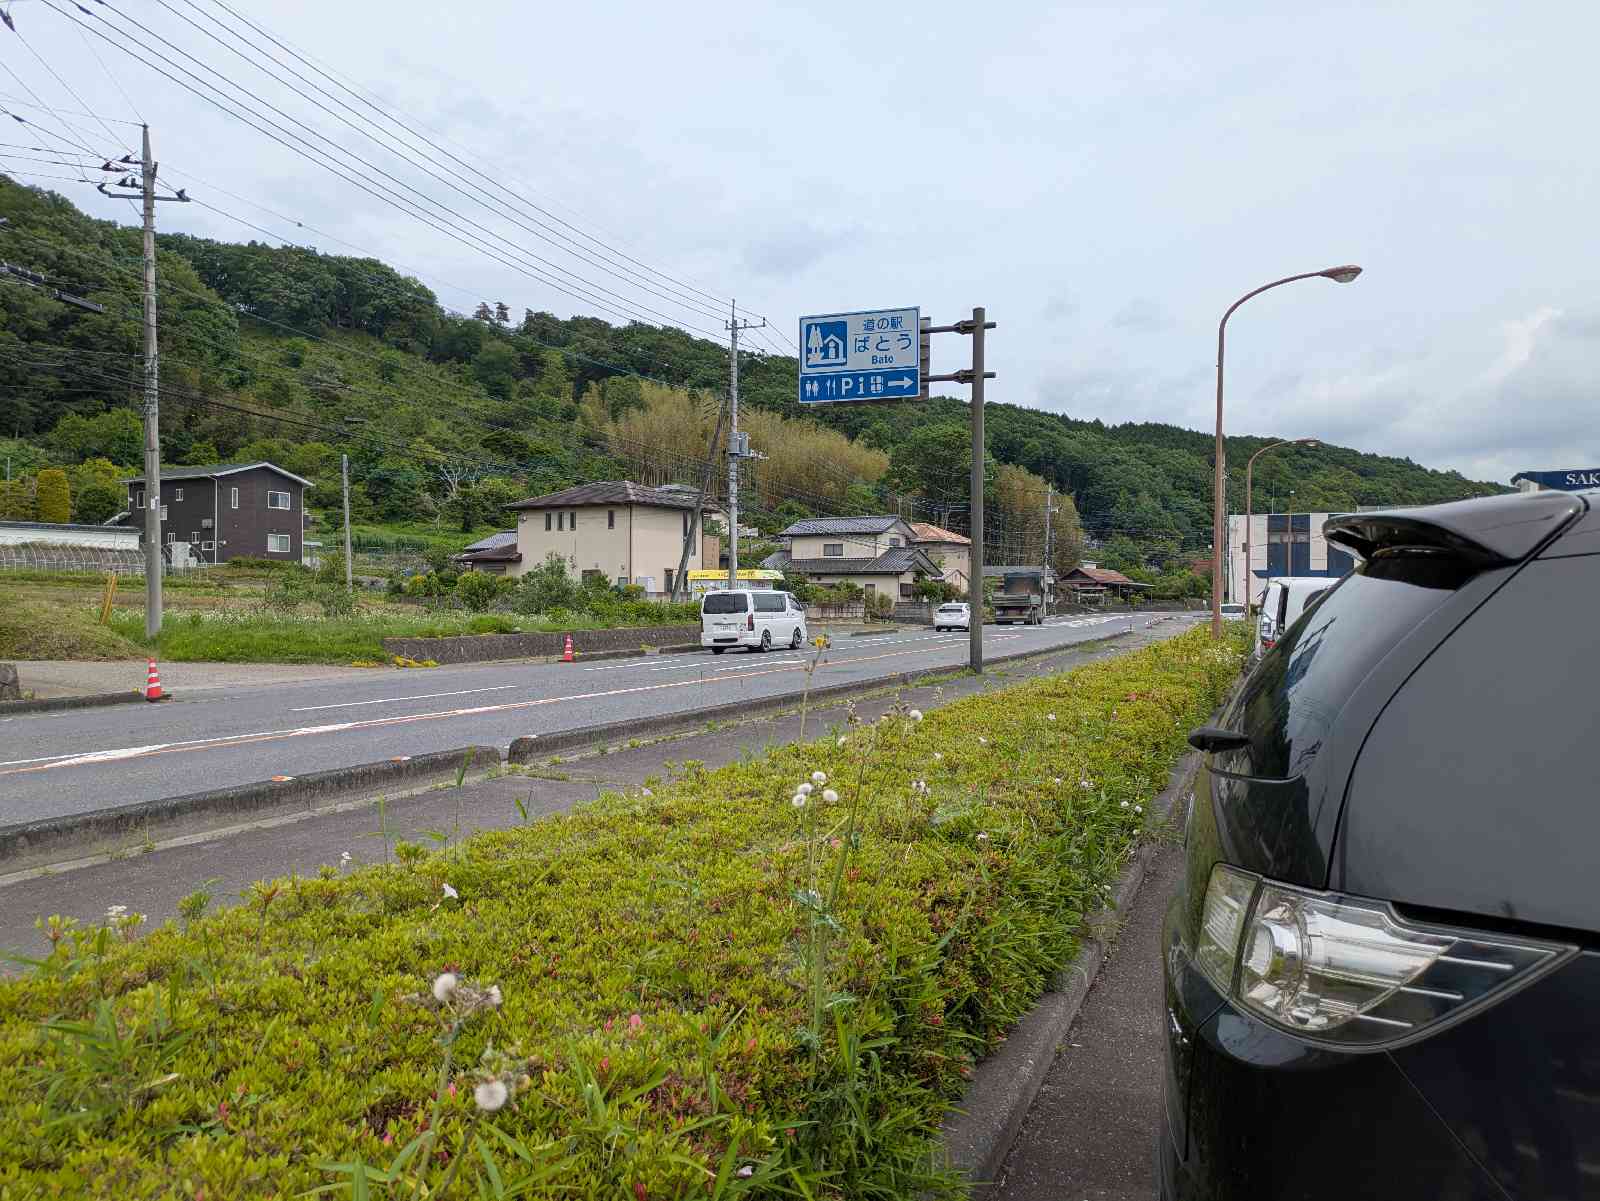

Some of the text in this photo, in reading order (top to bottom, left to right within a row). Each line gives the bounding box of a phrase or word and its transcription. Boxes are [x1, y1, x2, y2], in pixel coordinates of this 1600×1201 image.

[864, 316, 903, 331] 道の駅
[854, 333, 912, 353] ばとう
[871, 354, 894, 365] Bato
[841, 377, 853, 396] P
